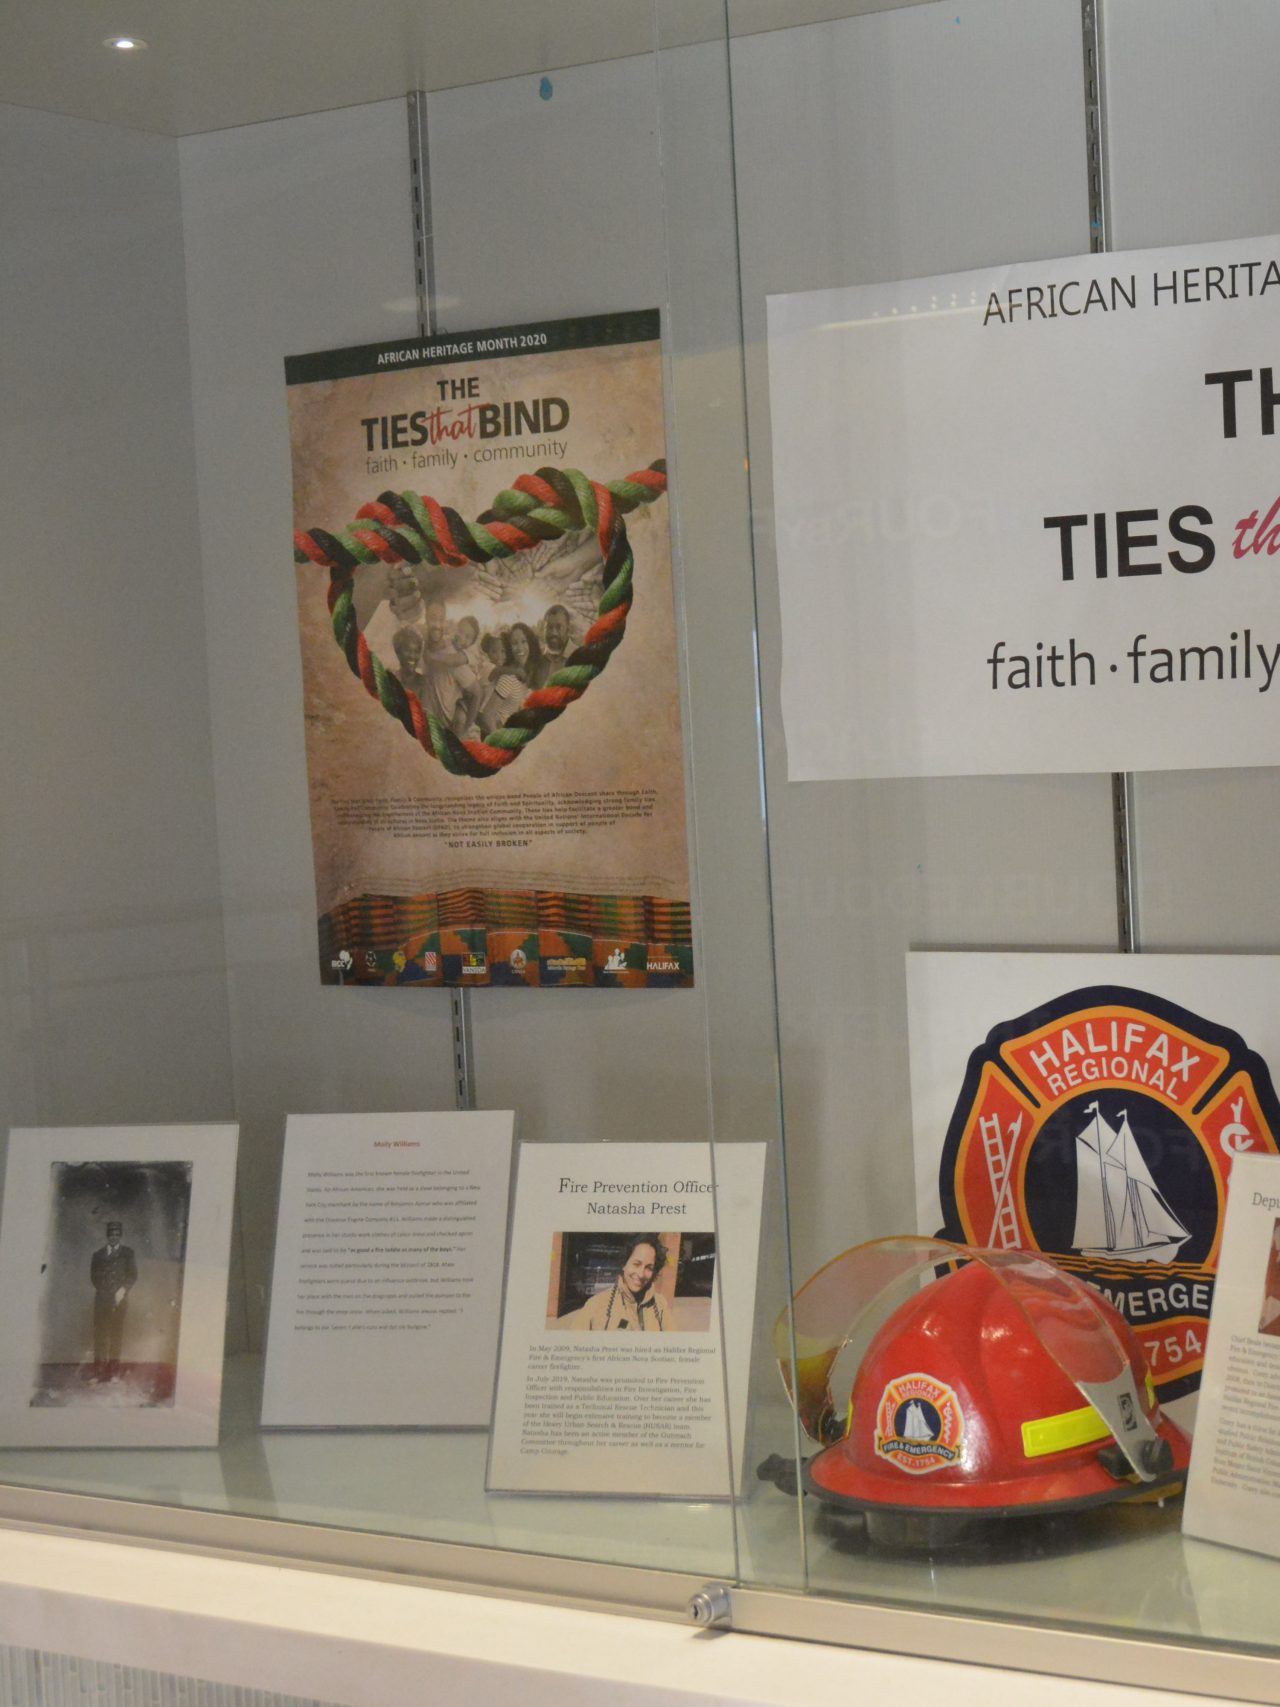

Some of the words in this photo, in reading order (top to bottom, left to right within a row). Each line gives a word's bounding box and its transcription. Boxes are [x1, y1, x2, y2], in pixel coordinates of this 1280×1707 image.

[983, 275, 1136, 326] AFRICAN
[377, 349, 419, 366] AFRICAN
[422, 343, 474, 359] HERITAGE
[476, 337, 518, 354] MONTH
[520, 333, 547, 348] 2020
[437, 377, 480, 401] THE
[361, 411, 428, 452] TIES
[424, 402, 491, 446] that
[479, 397, 570, 440] BIND
[366, 455, 398, 475] faith
[412, 449, 458, 470] family
[474, 439, 568, 463] community
[1043, 504, 1216, 581] TIES
[986, 637, 1096, 690] faith
[647, 962, 680, 970] HALIFAX
[1029, 1021, 1200, 1082] HALIFAX
[1048, 1056, 1179, 1101] REGIONAL
[559, 1177, 588, 1193] Fire
[593, 1181, 668, 1194] Prevention
[587, 1202, 646, 1215] Natasha
[651, 1203, 687, 1215] Prest
[1086, 1281, 1209, 1316] MERGE
[899, 1380, 939, 1397] HALIFAX
[905, 1444, 954, 1459] EMERGENCY
